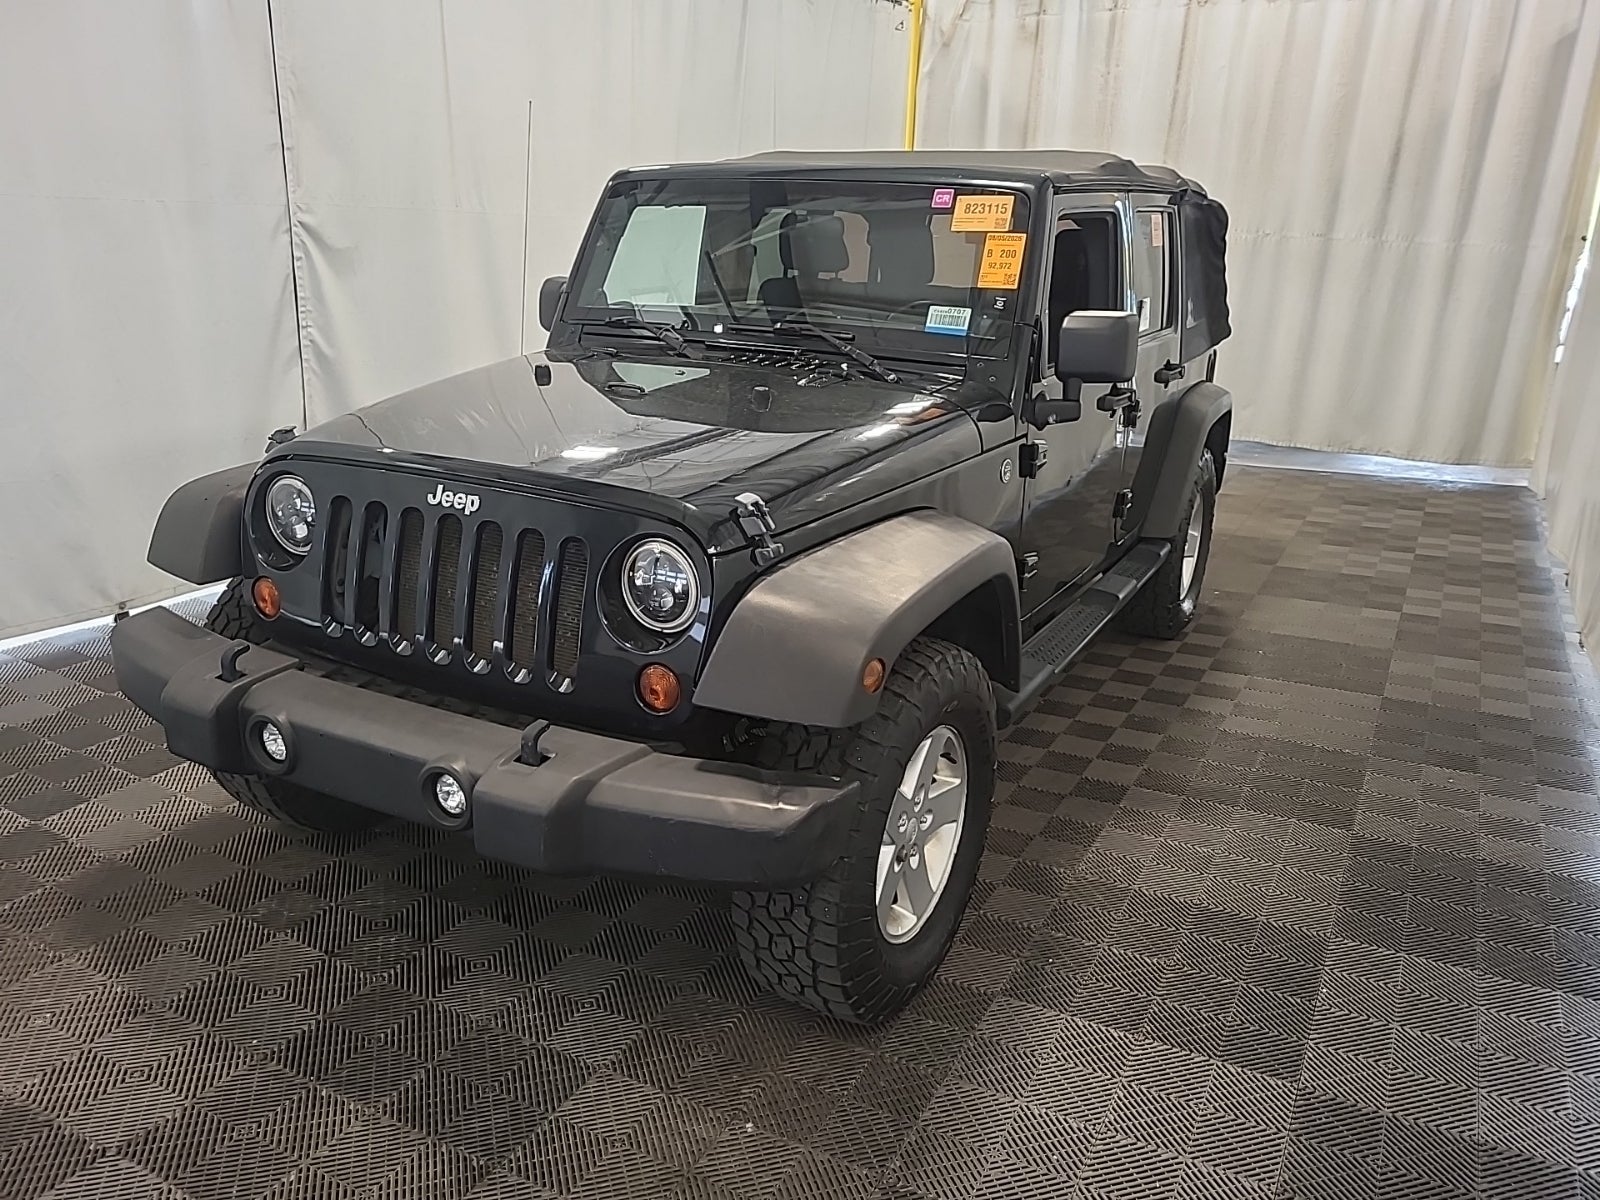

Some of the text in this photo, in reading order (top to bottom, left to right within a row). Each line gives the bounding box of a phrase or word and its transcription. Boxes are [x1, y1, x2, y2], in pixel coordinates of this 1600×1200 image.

[935, 195, 950, 203] CR
[964, 203, 1008, 215] 823115
[1000, 249, 1017, 259] 200
[427, 484, 480, 516] Jeep
